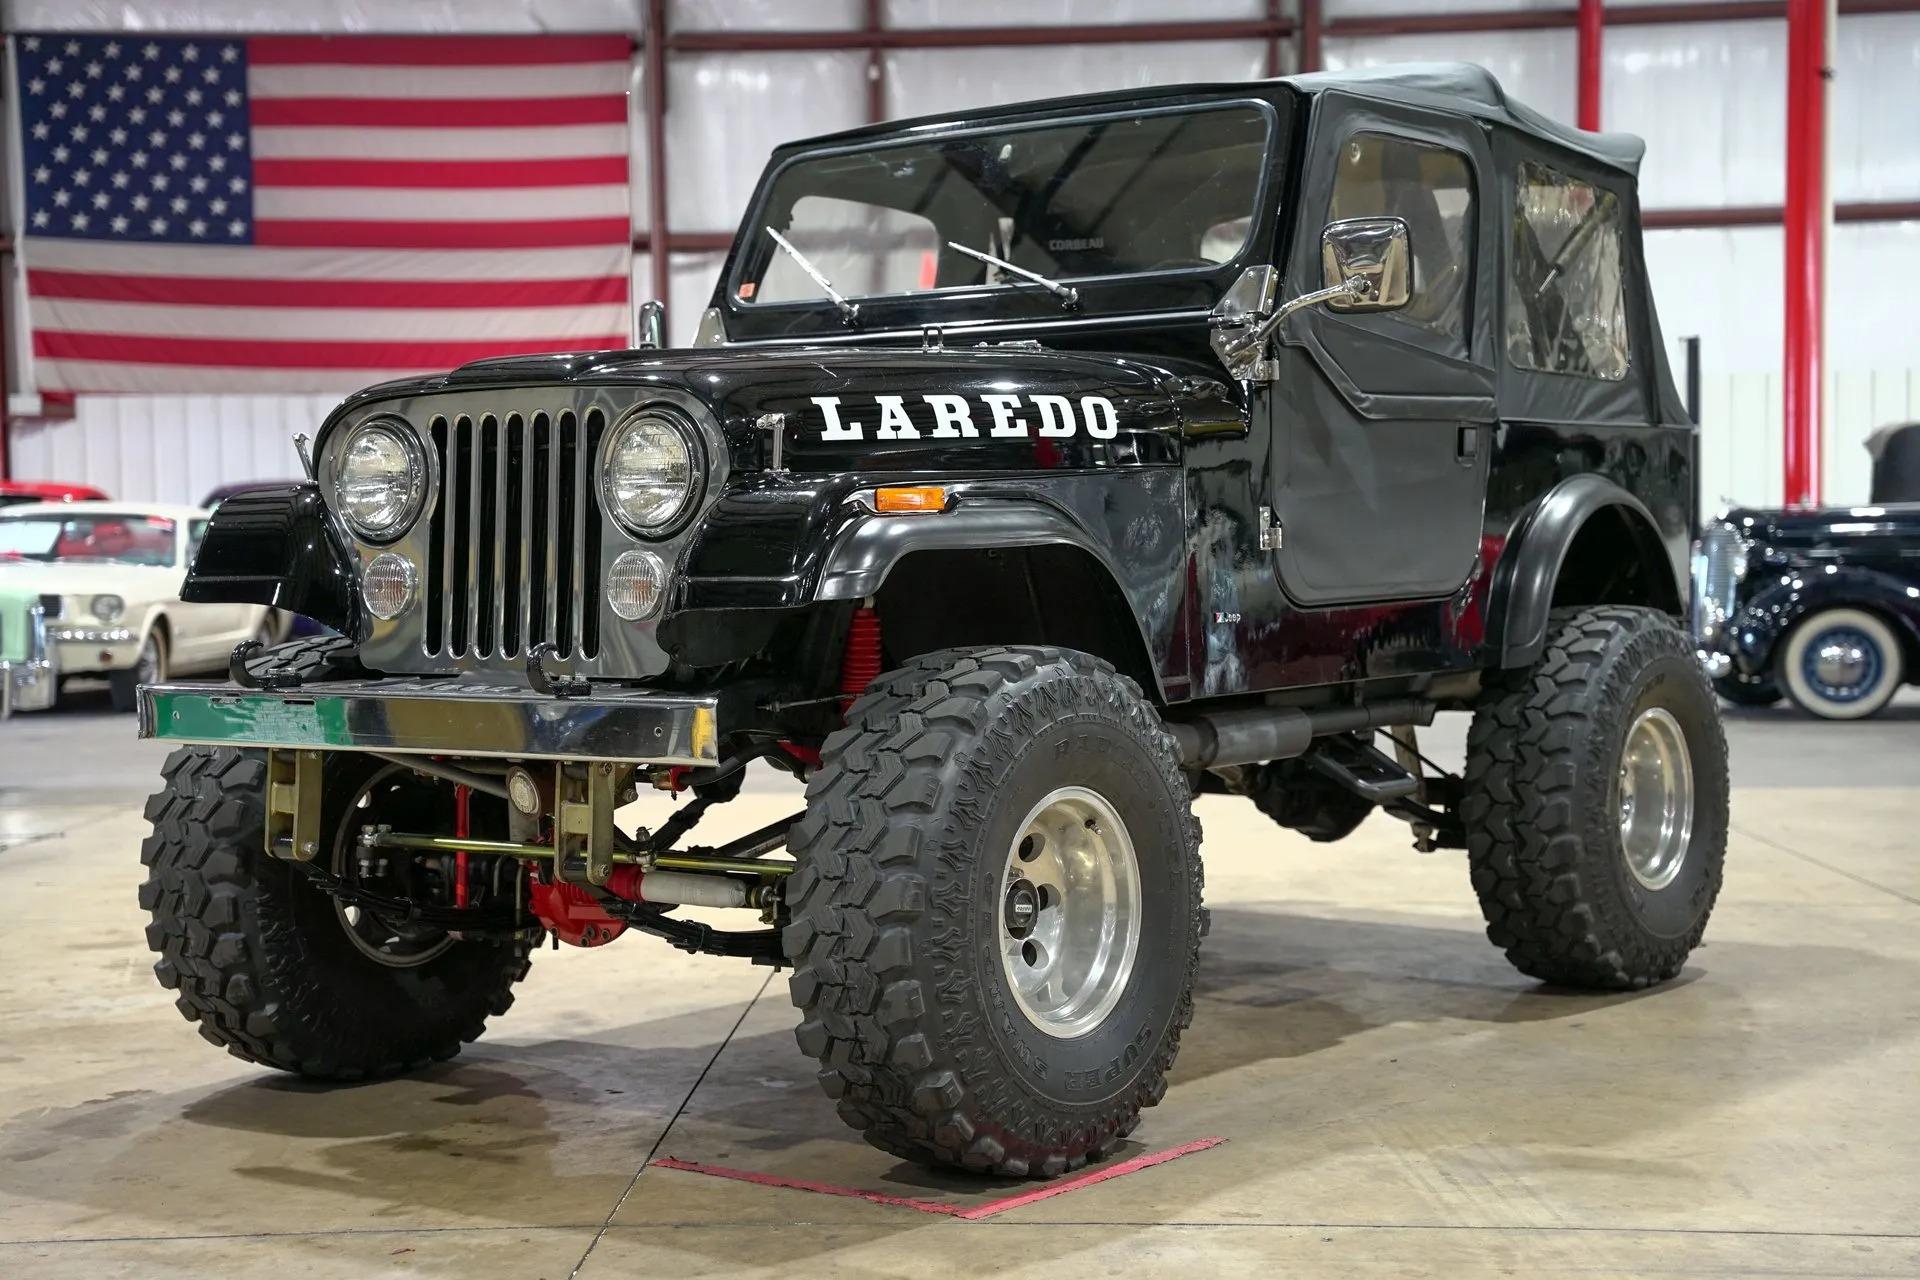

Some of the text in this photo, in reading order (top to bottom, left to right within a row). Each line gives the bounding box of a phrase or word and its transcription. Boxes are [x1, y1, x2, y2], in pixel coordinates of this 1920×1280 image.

[1048, 238, 1104, 251] CORBEAU
[810, 394, 1120, 441] LAREDO
[1064, 1021, 1152, 1092] SUPER
